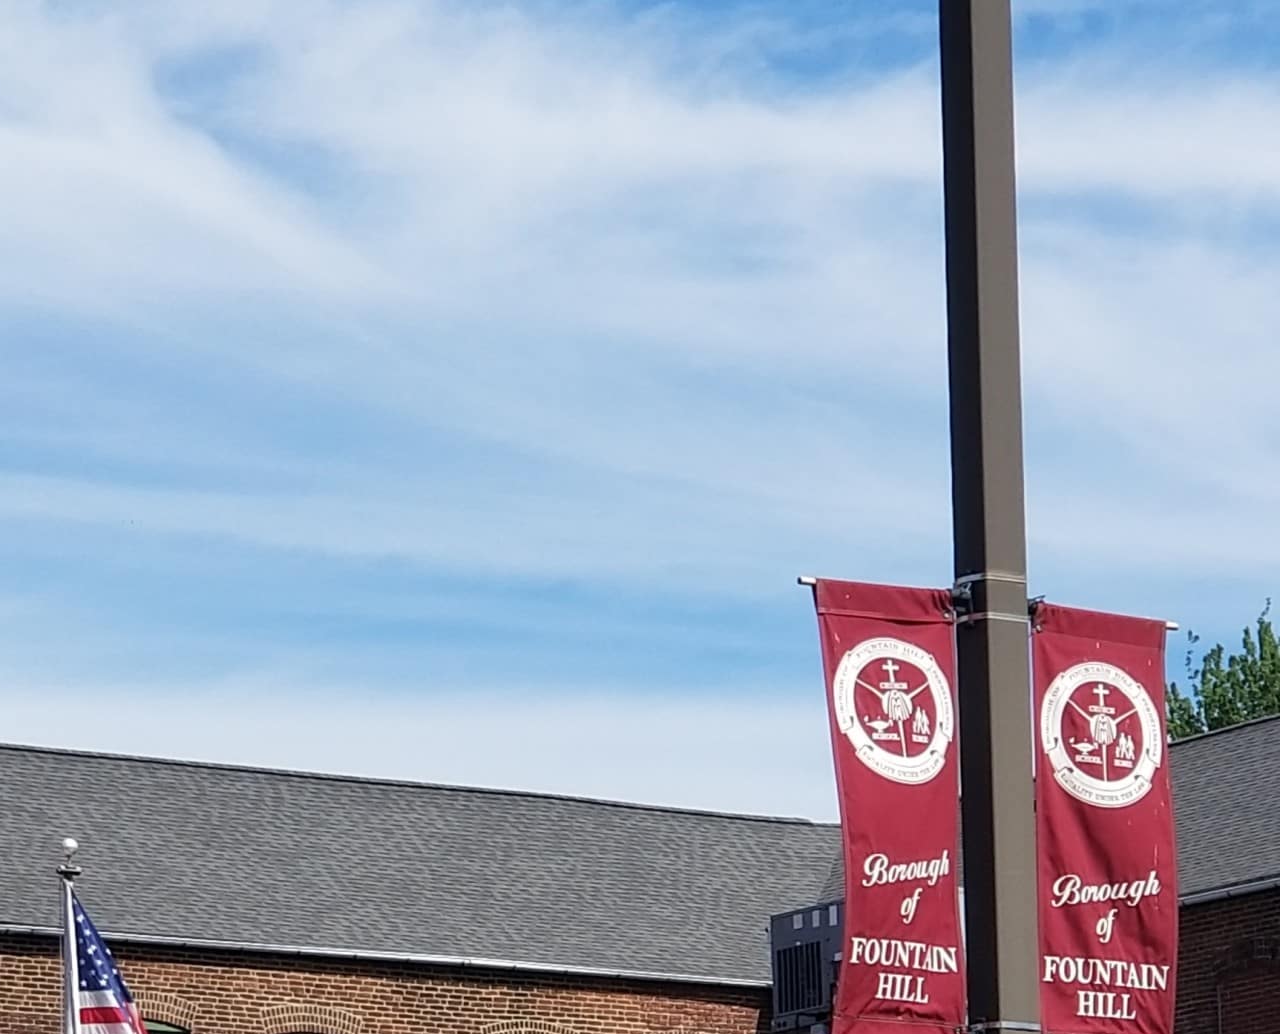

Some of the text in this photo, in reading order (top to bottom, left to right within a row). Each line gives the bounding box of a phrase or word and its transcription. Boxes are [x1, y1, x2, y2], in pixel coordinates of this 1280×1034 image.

[862, 849, 951, 887] Borough
[900, 887, 923, 925] of
[1051, 870, 1161, 908] Borough
[1095, 908, 1118, 944] of
[849, 936, 959, 973] FOUNTAIN
[875, 972, 929, 1004] HILL
[1042, 955, 1170, 991] FOUNTAIN
[1076, 989, 1137, 1020] HILL
